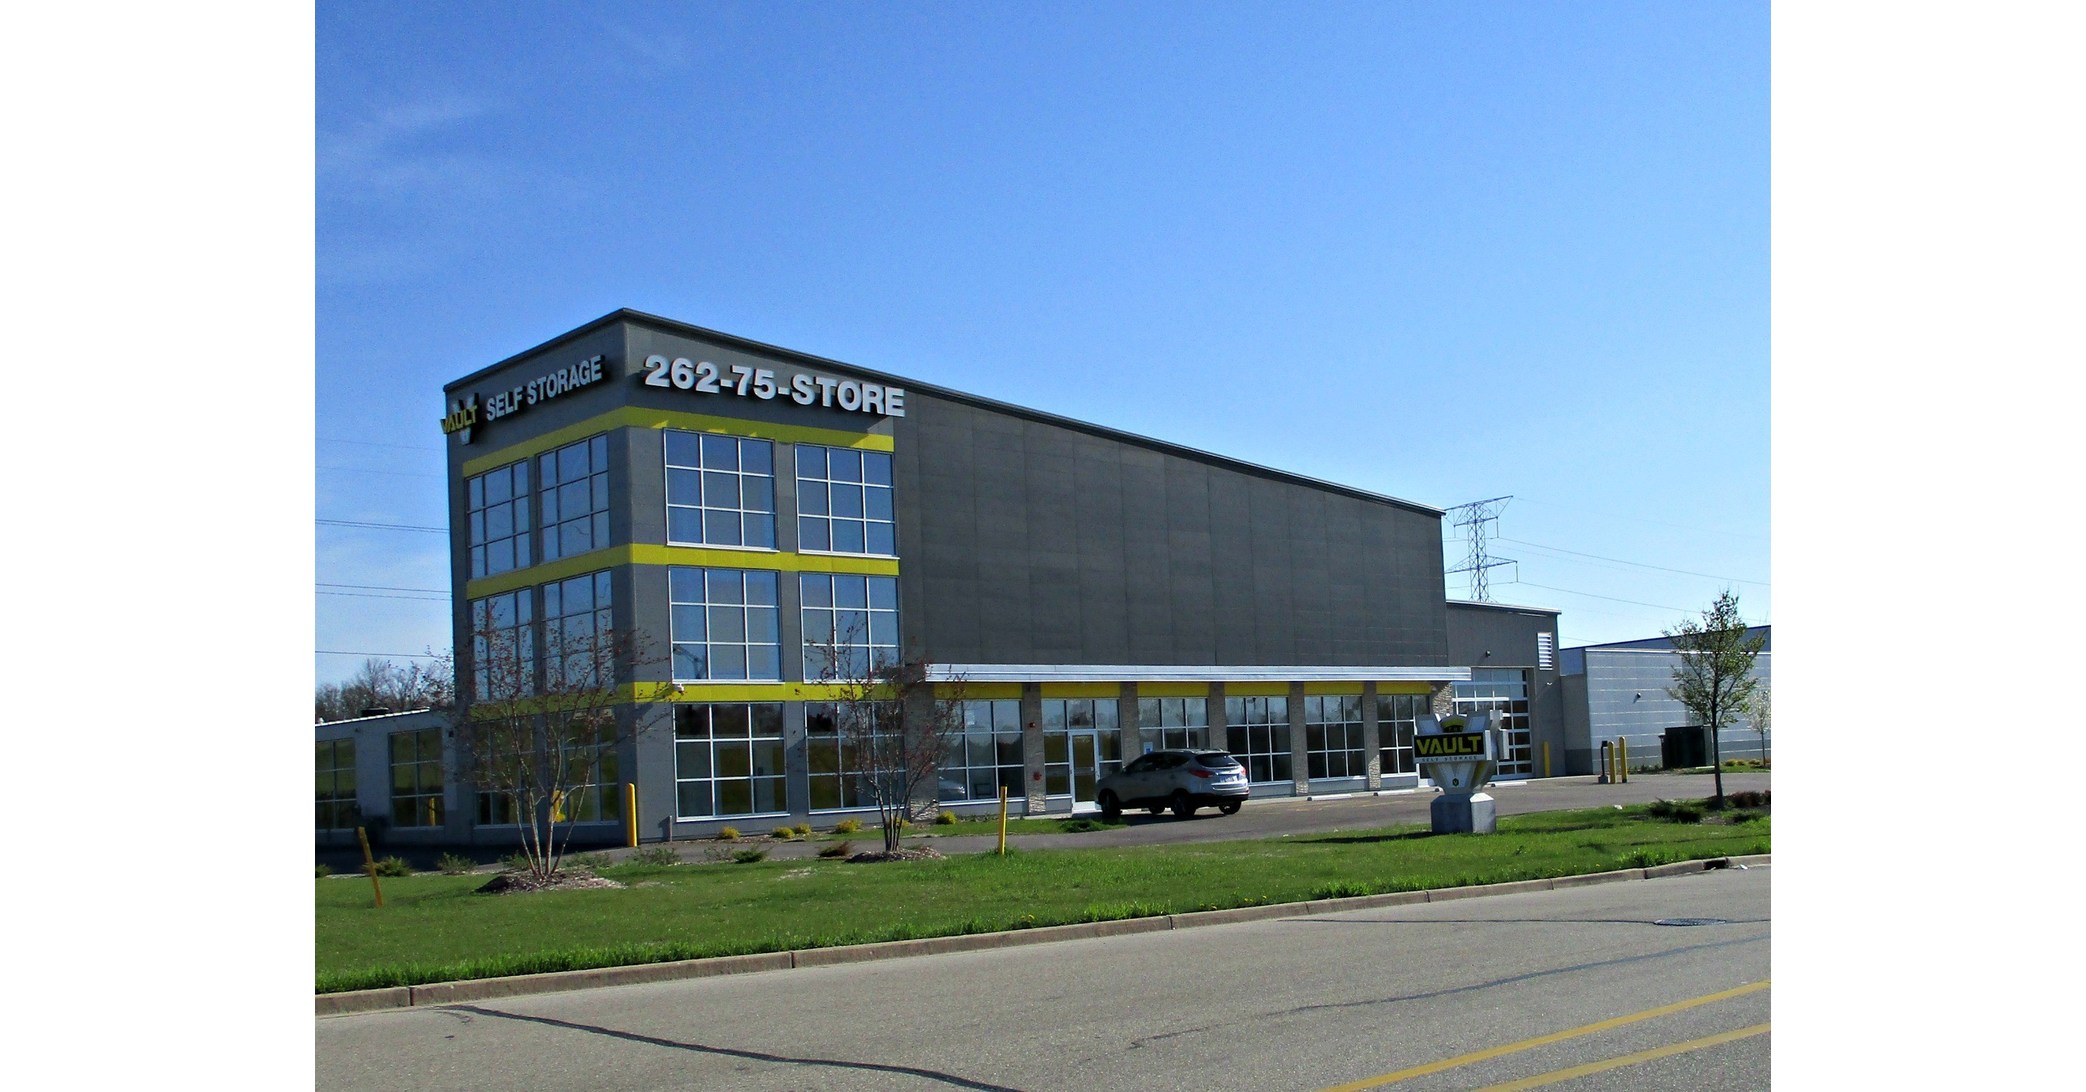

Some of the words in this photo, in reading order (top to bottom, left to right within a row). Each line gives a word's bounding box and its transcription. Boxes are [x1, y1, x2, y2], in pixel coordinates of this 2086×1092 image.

[486, 386, 524, 422] SELF
[527, 355, 603, 405] STORAGE
[644, 354, 905, 418] 262-75-STORE
[440, 404, 479, 435] VAULT
[1416, 735, 1482, 755] VAULT
